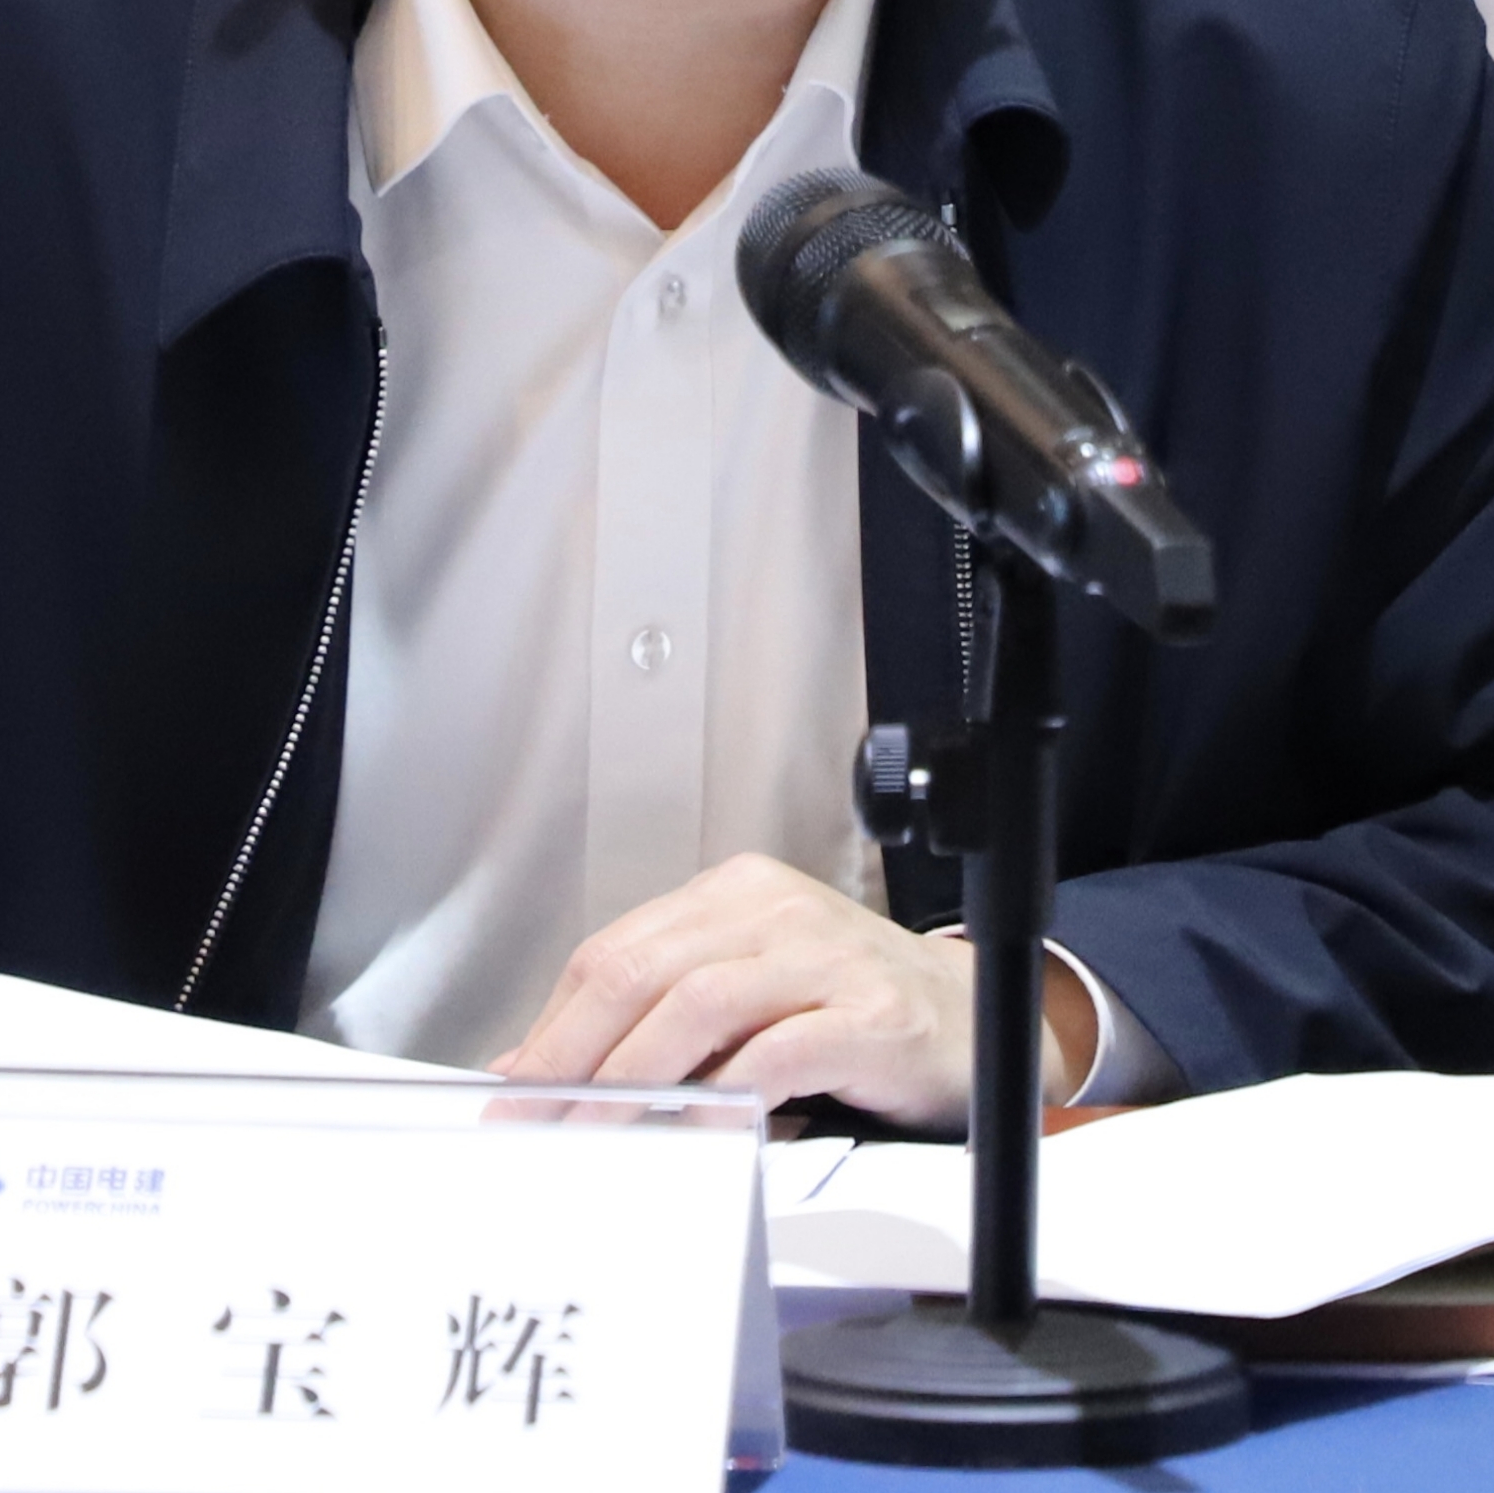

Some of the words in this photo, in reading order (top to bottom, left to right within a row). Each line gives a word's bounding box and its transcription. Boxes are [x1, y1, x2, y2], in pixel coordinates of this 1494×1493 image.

[26, 1164, 166, 1195] 中国电建
[22, 1199, 161, 1216] POWERCHINA
